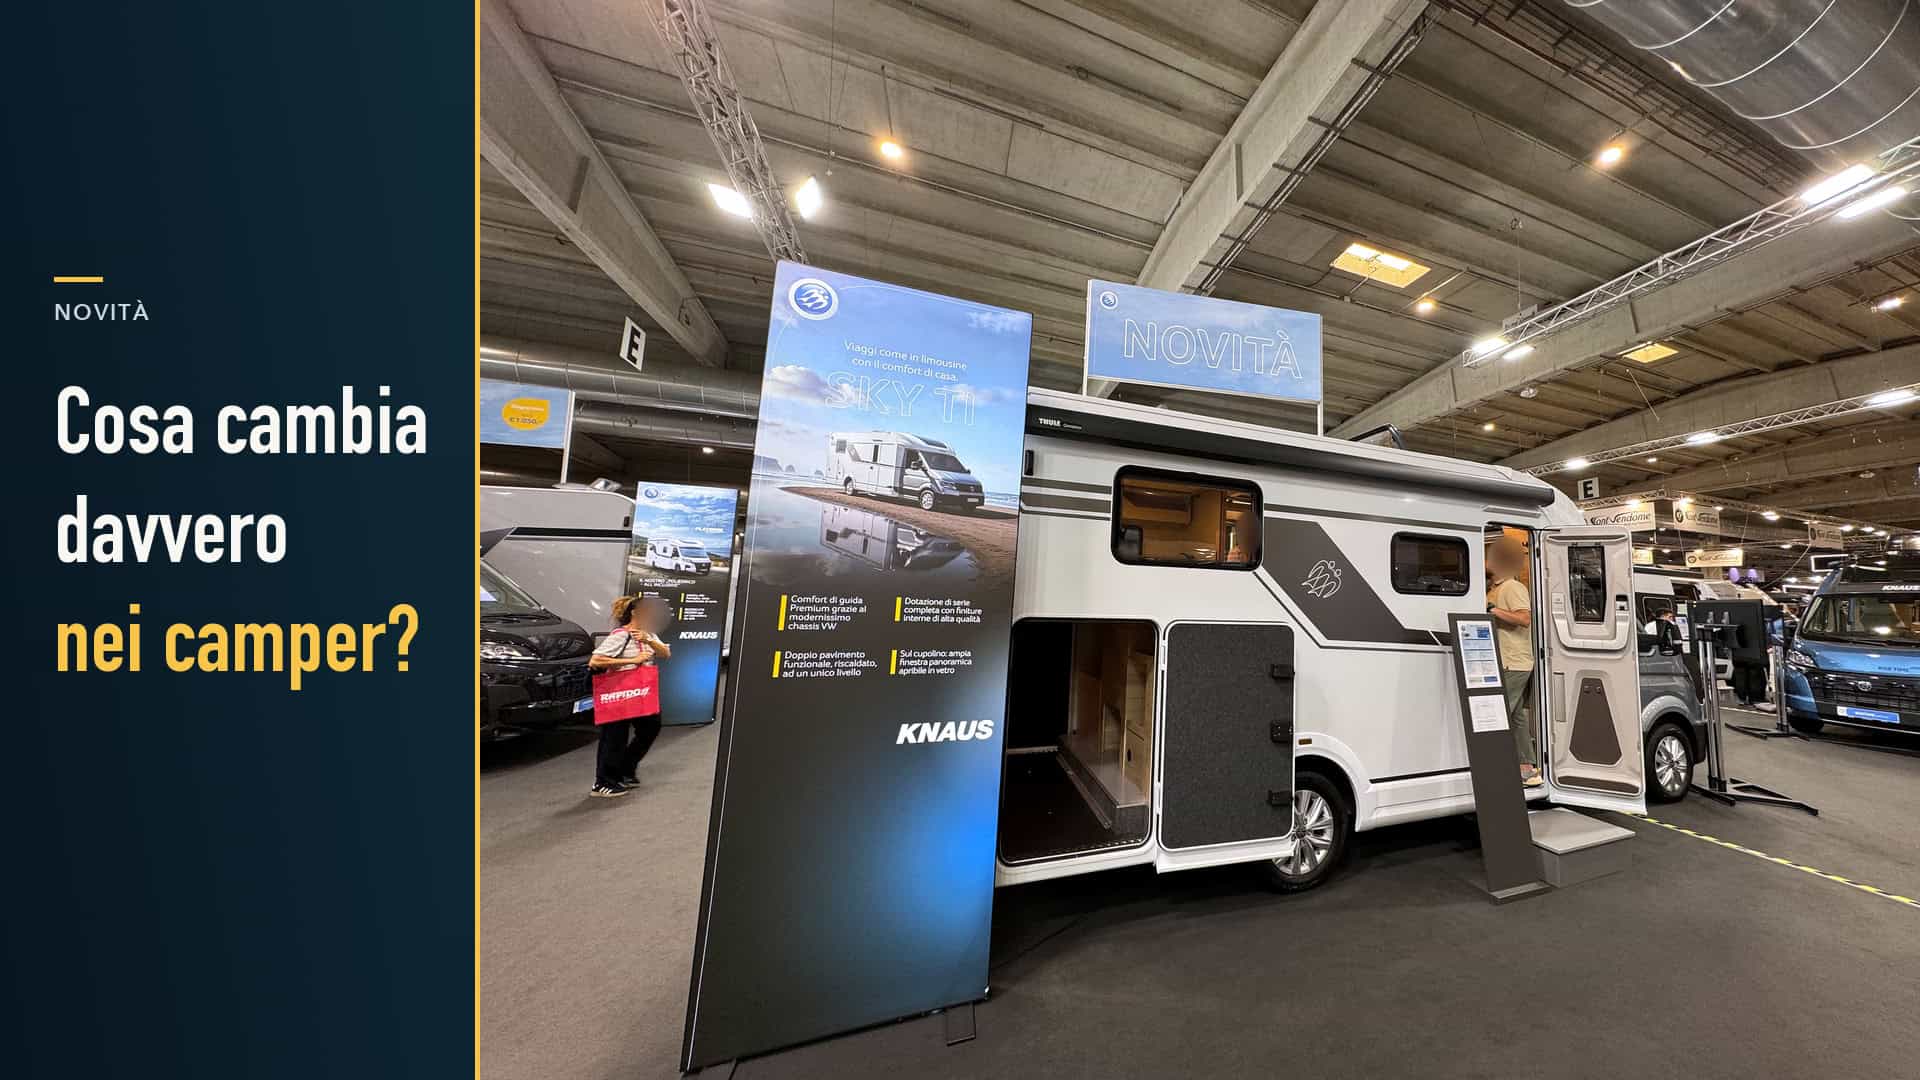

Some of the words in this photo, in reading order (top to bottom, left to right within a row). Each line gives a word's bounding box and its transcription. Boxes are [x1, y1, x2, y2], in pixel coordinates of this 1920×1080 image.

[627, 325, 641, 365] E
[1123, 319, 1302, 379] NOVITÀ
[844, 340, 877, 356] Viaggi
[879, 348, 908, 360] come
[910, 351, 919, 361] in
[921, 353, 967, 370] limousine
[851, 357, 872, 367] con
[873, 359, 880, 369] il
[881, 361, 922, 375] comfort
[924, 367, 933, 377] di
[825, 370, 925, 417] SKY
[1038, 417, 1061, 427] THULE
[1582, 480, 1594, 499] E
[791, 594, 828, 604] Comfort
[829, 595, 838, 604] di
[839, 595, 864, 606] guida
[904, 597, 944, 606] Dotazione
[944, 598, 952, 606] di
[952, 599, 971, 607] serie
[790, 603, 830, 613] Premium
[831, 605, 858, 615] grazie
[859, 605, 867, 614] al
[903, 606, 940, 616] completa
[955, 606, 983, 615] finiture
[788, 612, 851, 622] modernissimo
[940, 615, 955, 623] alta
[955, 615, 981, 625] qualità
[787, 621, 820, 631] chassis
[820, 622, 838, 631] VW
[679, 631, 719, 640] KNAUS
[784, 650, 818, 660] Doppio
[819, 650, 866, 660] pavimento
[900, 649, 913, 658] Sul
[948, 650, 972, 659] ampia
[783, 659, 833, 669] funzionale,
[834, 659, 878, 669] riscaldato,
[899, 658, 929, 667] finestra
[929, 658, 973, 668] panoramica
[782, 669, 795, 678] ad
[796, 670, 809, 678] un
[810, 668, 836, 677] unico
[836, 668, 862, 677] livello
[898, 666, 927, 676] apribile
[600, 688, 641, 702] RAPIDO
[896, 719, 995, 745] KNAUS
